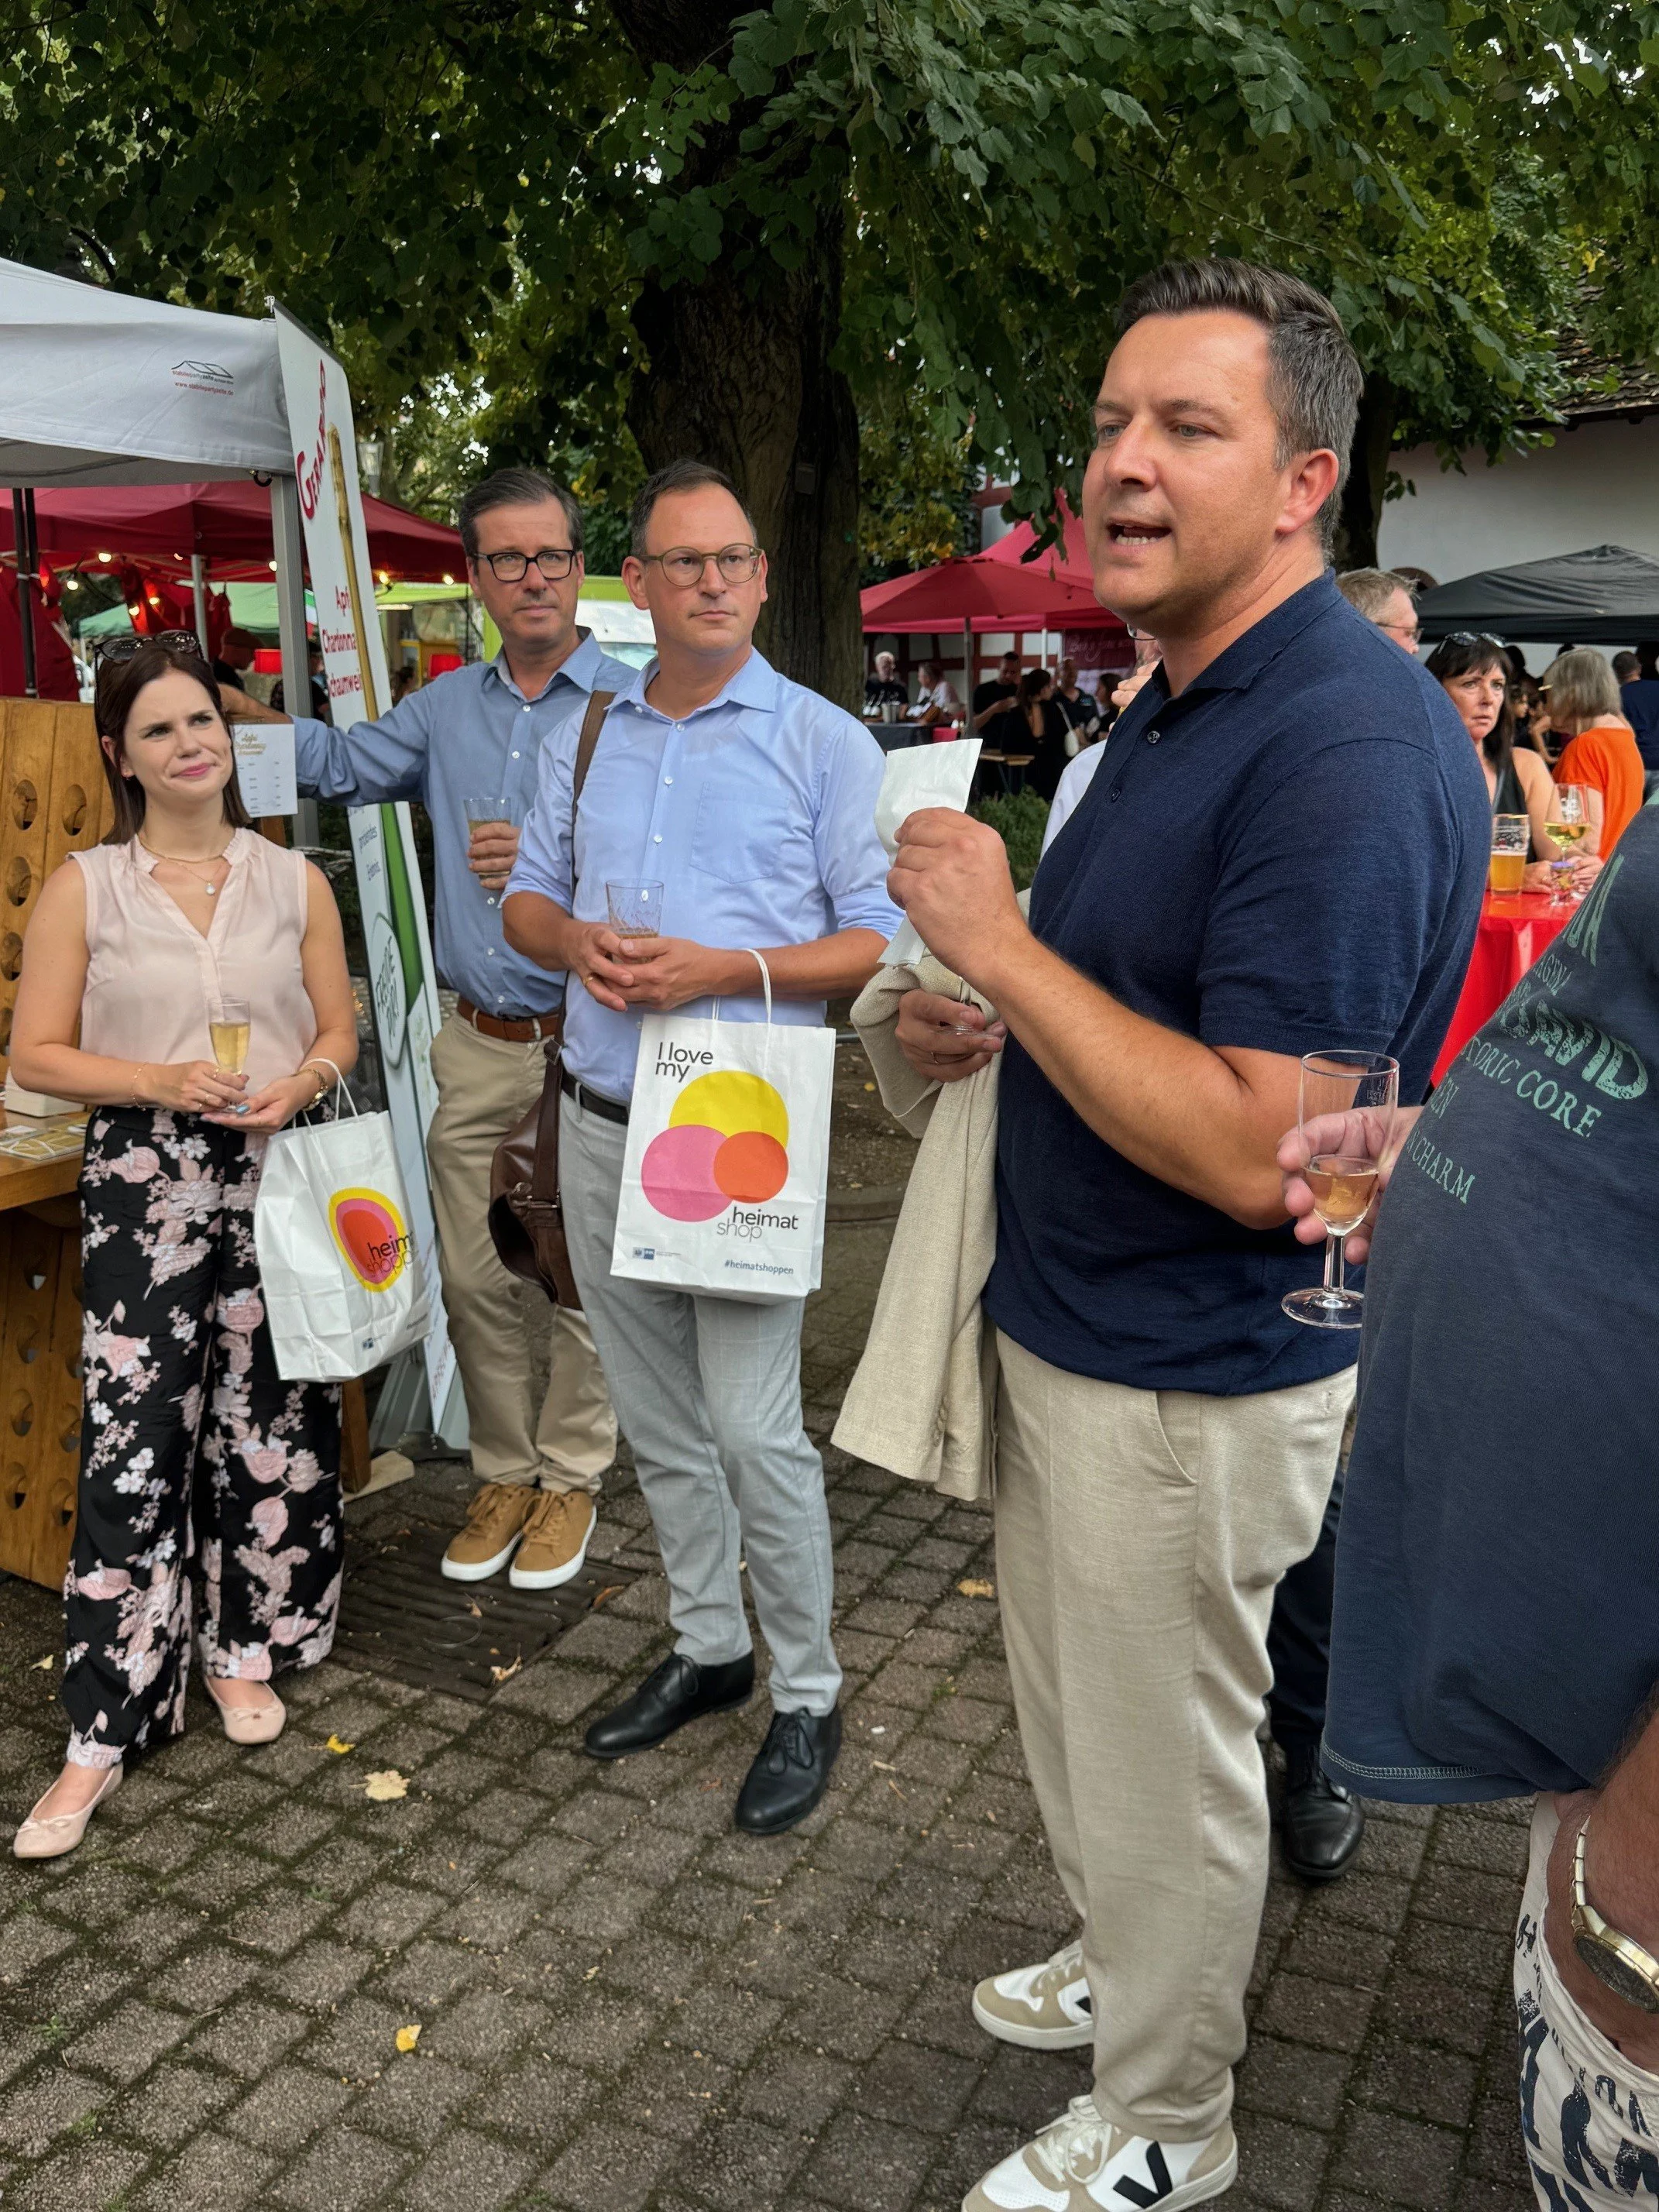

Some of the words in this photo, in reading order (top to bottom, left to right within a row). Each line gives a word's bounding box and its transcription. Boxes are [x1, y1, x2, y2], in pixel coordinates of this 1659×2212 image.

[322, 628, 357, 654] Chardonna
[658, 1041, 664, 1060] I
[668, 1041, 714, 1066] love
[655, 1061, 691, 1084] my
[1461, 1036, 1521, 1084] TORIC
[1516, 1070, 1602, 1138] CORE
[1412, 1137, 1475, 1204] CHARM
[716, 1218, 763, 1243] shop
[733, 1206, 799, 1230] heimat
[367, 1231, 415, 1261] heim
[724, 1259, 795, 1276] #heimatshoppen
